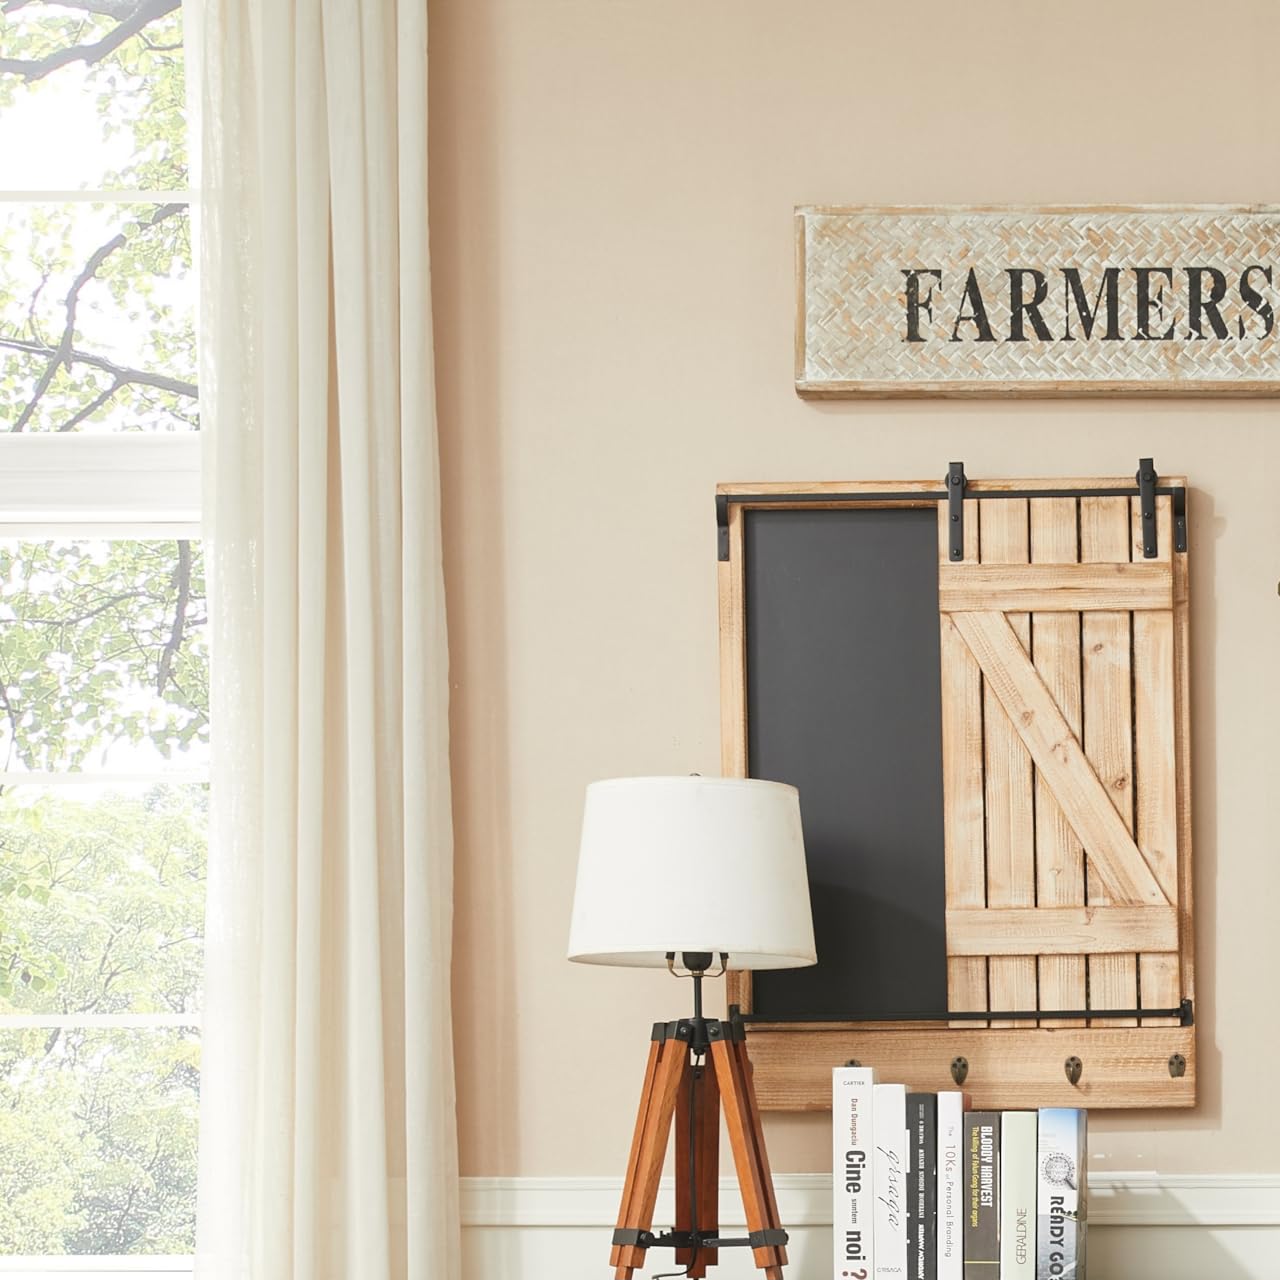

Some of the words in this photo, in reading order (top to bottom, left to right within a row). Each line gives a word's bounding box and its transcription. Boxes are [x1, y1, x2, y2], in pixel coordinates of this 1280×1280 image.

[900, 264, 1275, 344] FARMERS
[850, 1098, 859, 1112] Dan
[849, 1113, 859, 1146] Dungaciu
[971, 1126, 979, 1137] The
[980, 1126, 993, 1163] BLOODY
[844, 1150, 867, 1194] Cine
[945, 1144, 956, 1172] 10Ks
[945, 1181, 955, 1218] Personal
[970, 1174, 979, 1189] Gong
[980, 1165, 993, 1208] HARVEST
[944, 1220, 955, 1258] Branding
[1015, 1208, 1027, 1265] GERALDINE
[1049, 1196, 1064, 1248] READY
[845, 1230, 867, 1261] noi
[842, 1268, 868, 1280] ?
